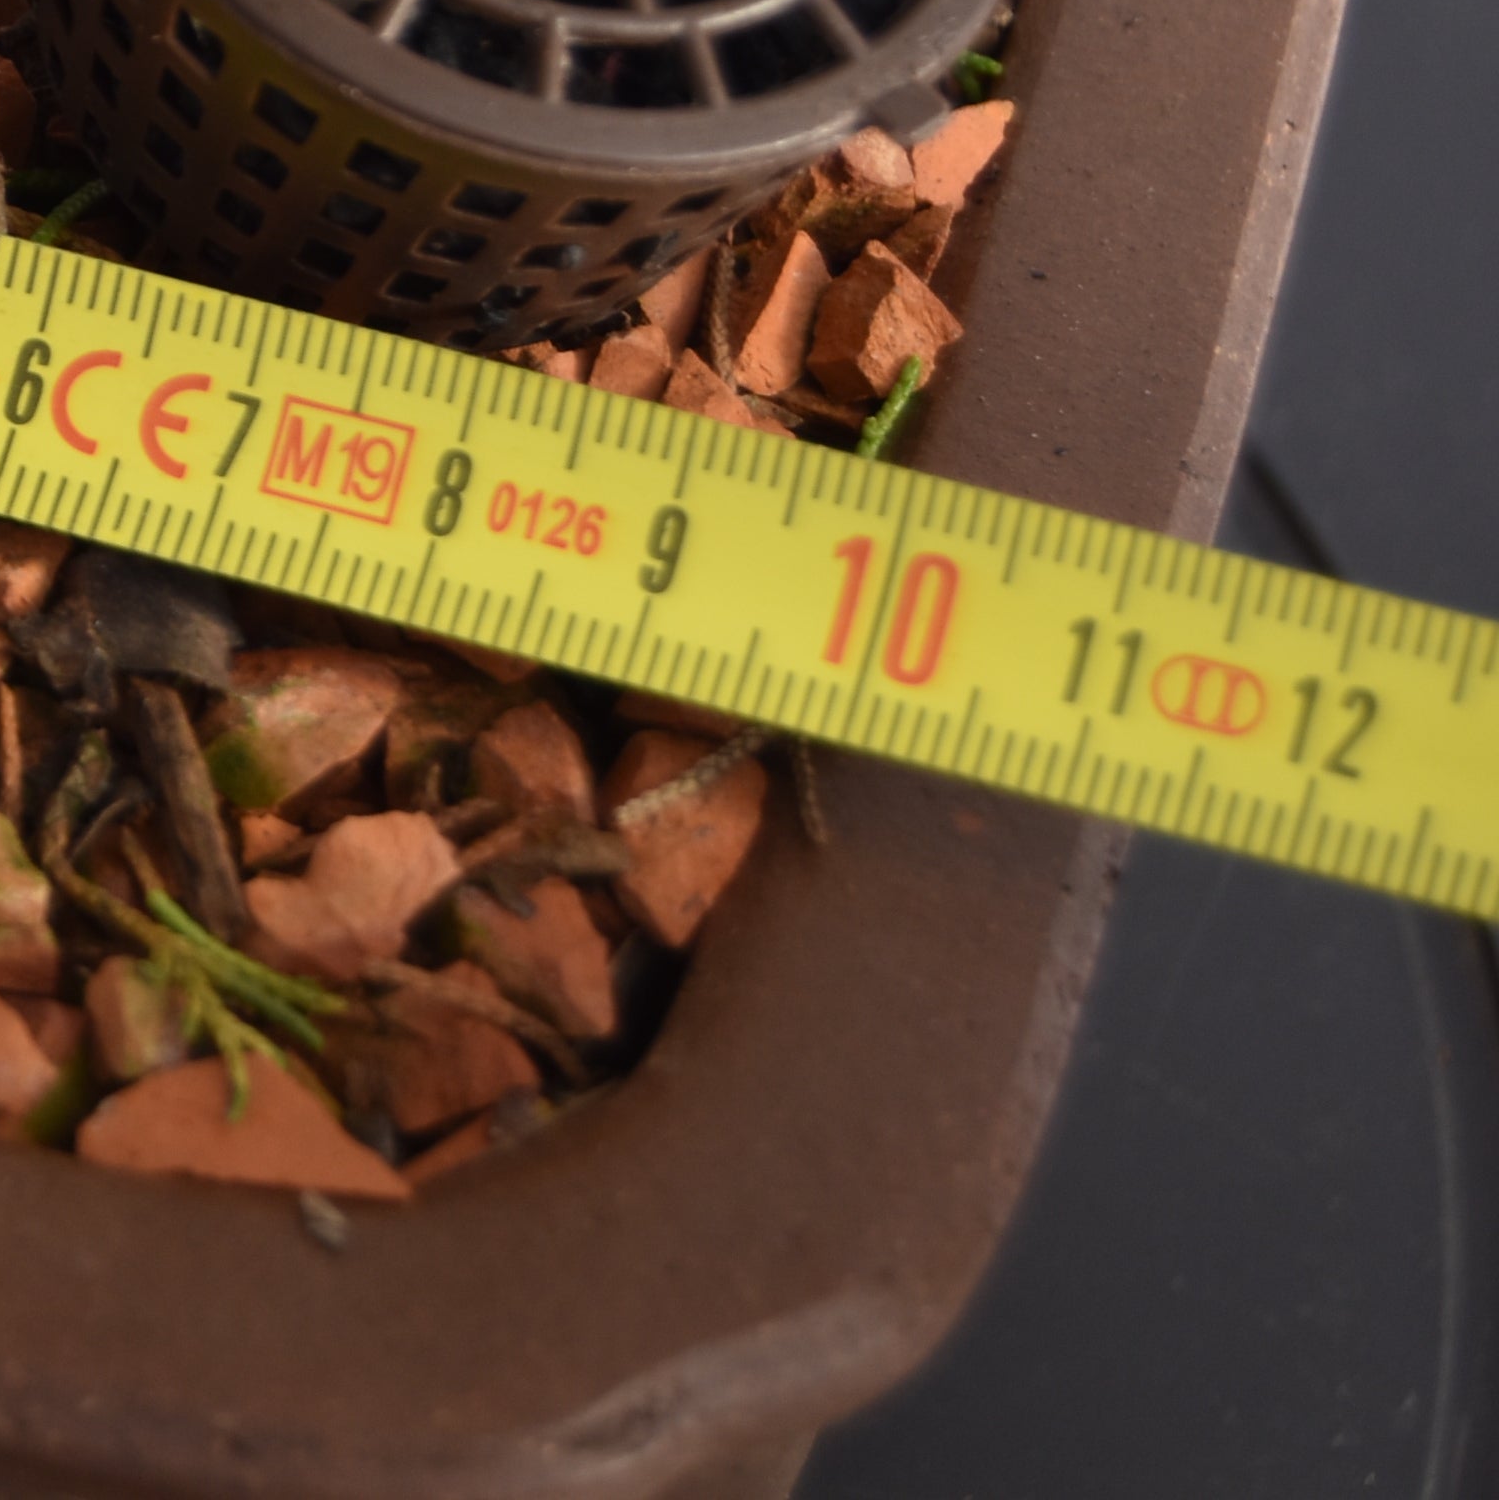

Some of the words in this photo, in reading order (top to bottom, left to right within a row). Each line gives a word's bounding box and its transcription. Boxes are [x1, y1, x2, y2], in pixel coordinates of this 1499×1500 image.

[4, 337, 52, 426] 6
[51, 349, 212, 480] CE
[215, 391, 263, 478] 7
[423, 447, 474, 538] 8
[486, 480, 609, 557] 0126
[638, 505, 689, 595] 9
[820, 534, 961, 687] 10
[1061, 615, 1147, 718] 11
[1286, 674, 1380, 781] 12
